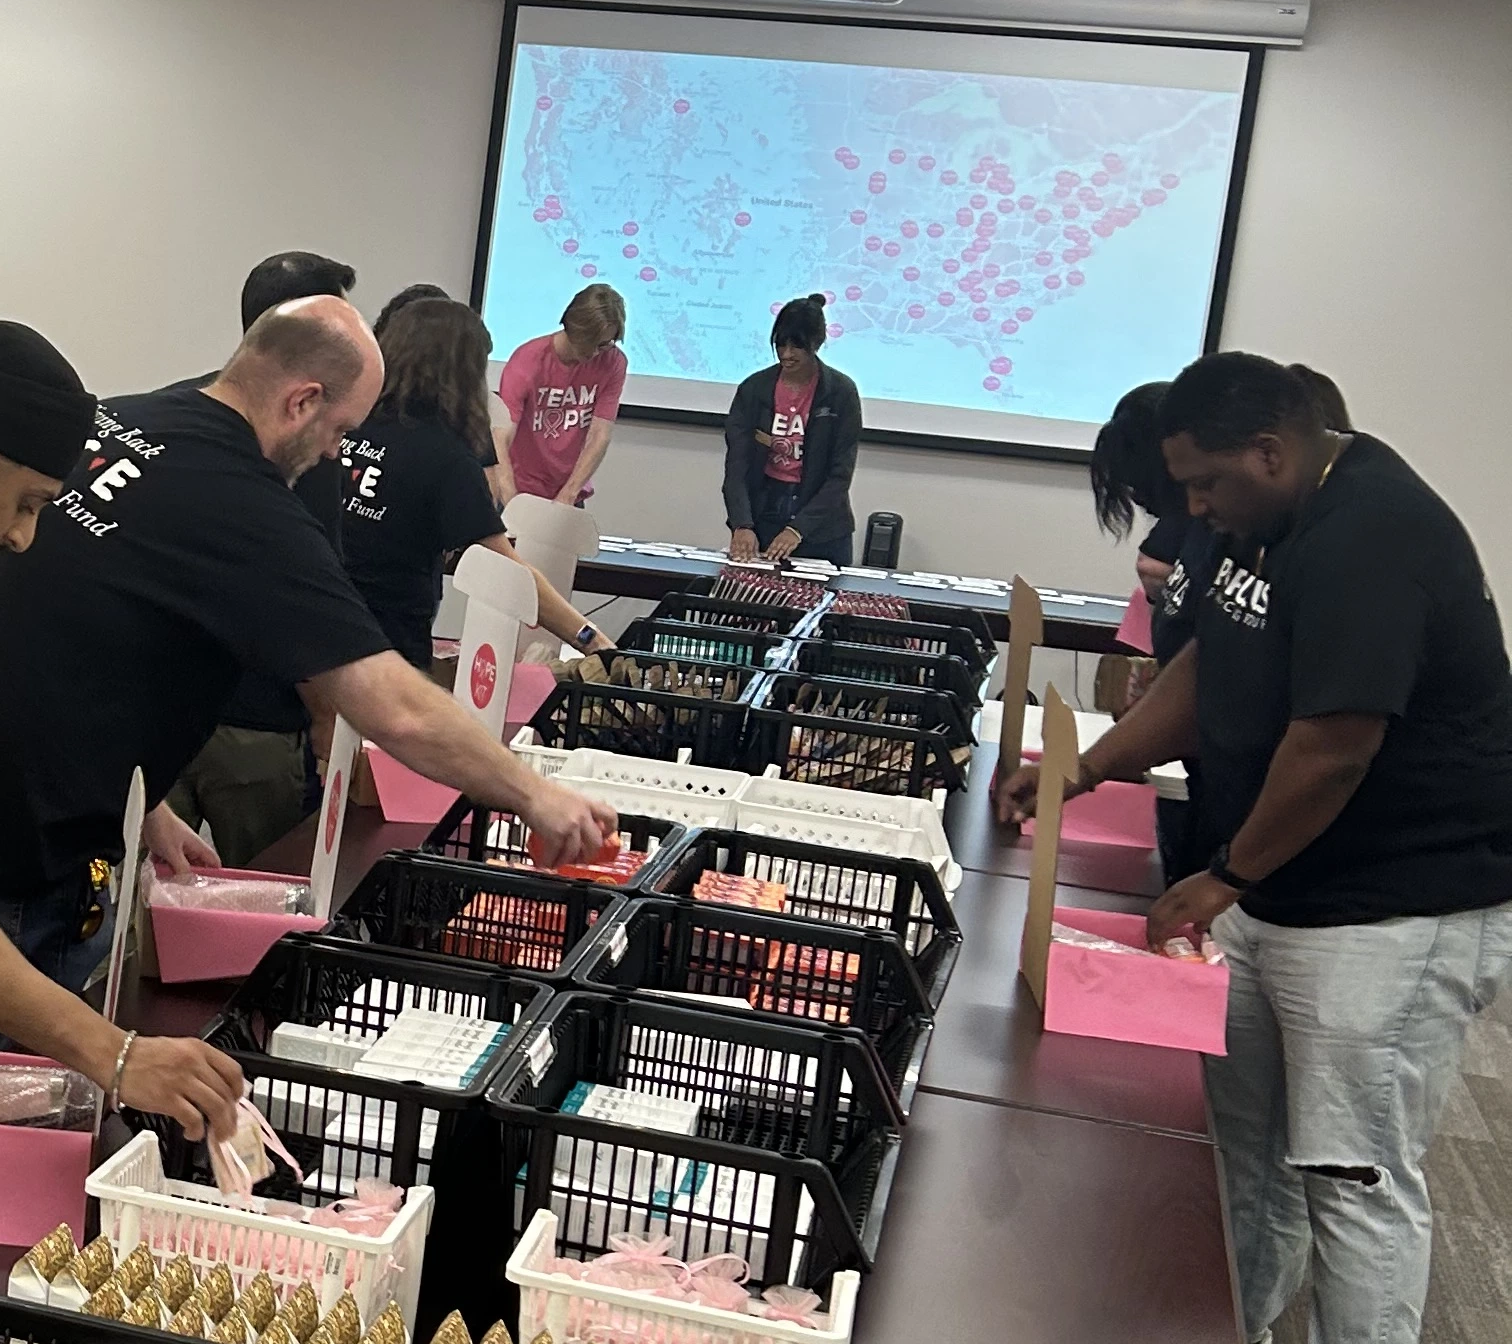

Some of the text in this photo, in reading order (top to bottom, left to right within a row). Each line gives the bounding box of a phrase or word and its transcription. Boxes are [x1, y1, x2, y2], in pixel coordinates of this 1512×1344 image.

[751, 196, 814, 209] United States
[537, 384, 599, 407] TEAM
[532, 408, 594, 439] HOPE
[771, 414, 805, 437] EA
[114, 427, 166, 460] Back
[355, 439, 387, 462] Back
[53, 489, 119, 537] Fund
[347, 496, 388, 521] Fund
